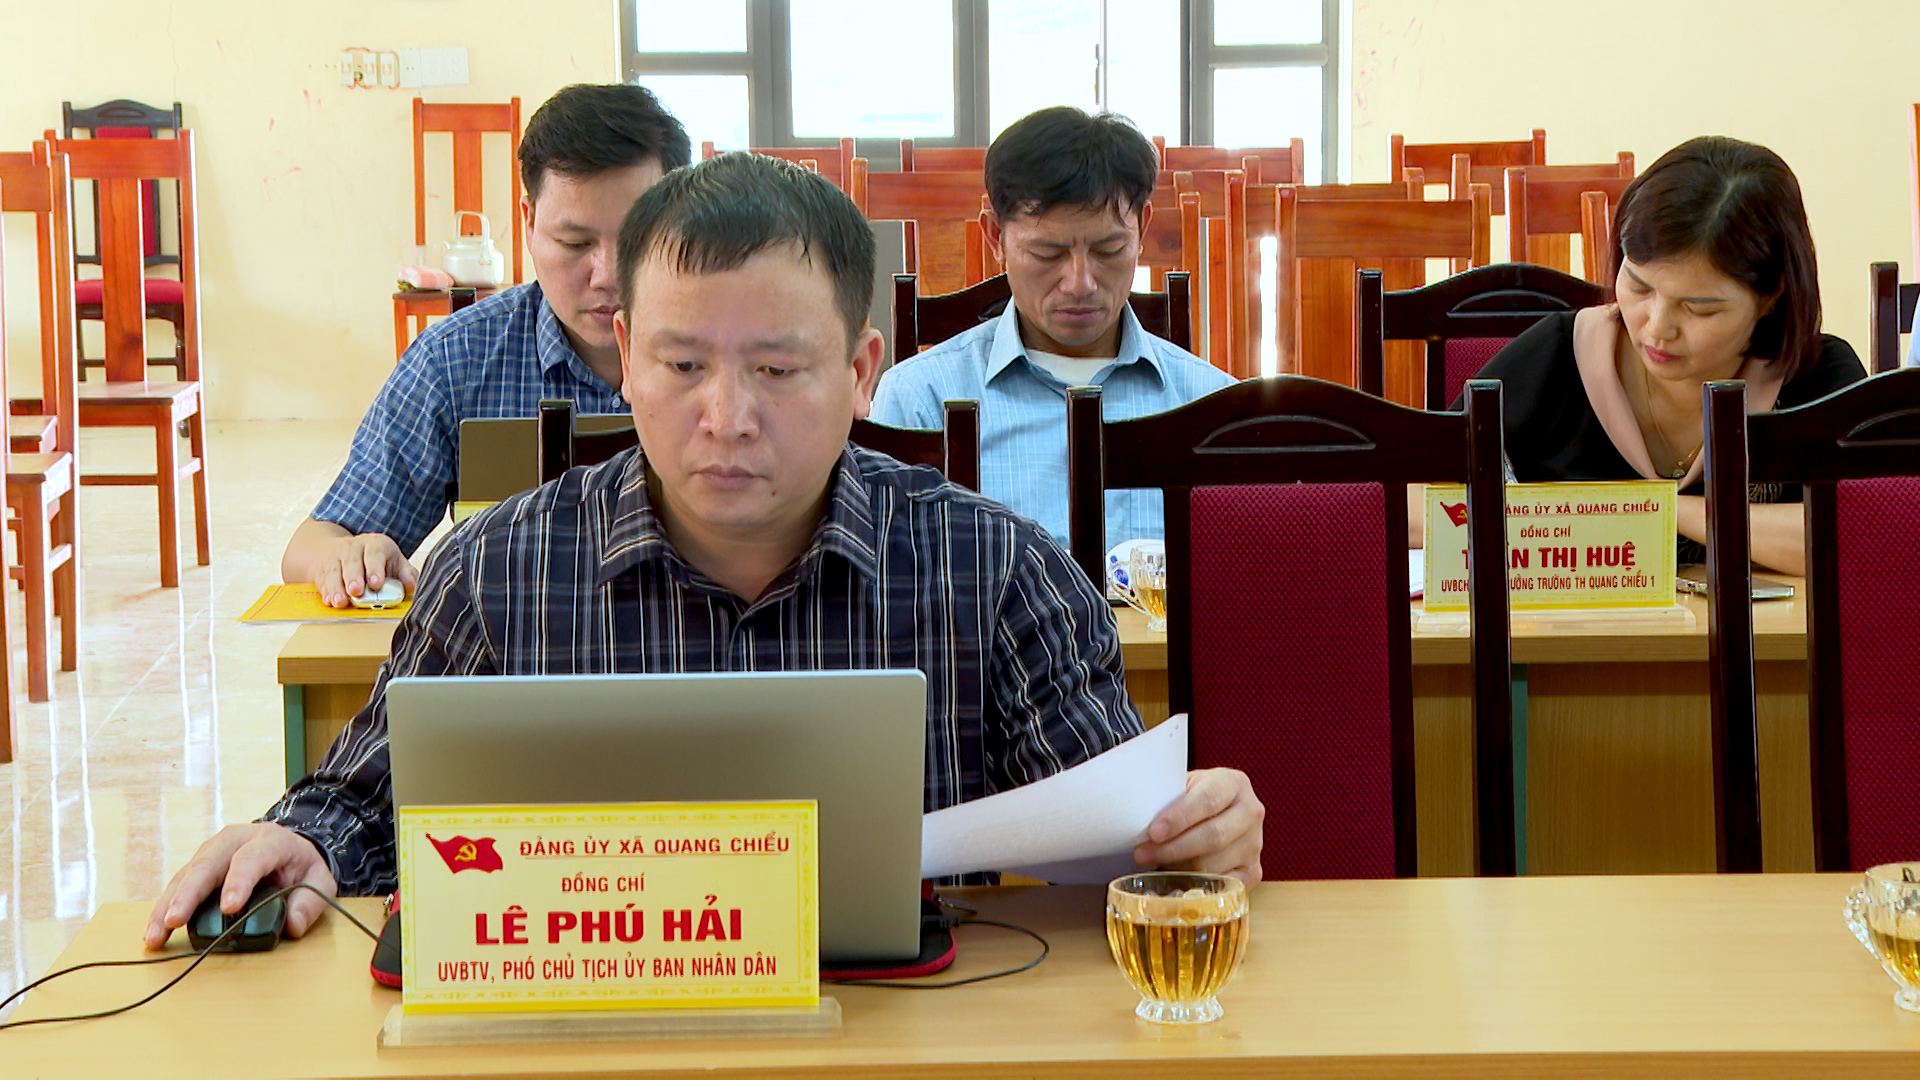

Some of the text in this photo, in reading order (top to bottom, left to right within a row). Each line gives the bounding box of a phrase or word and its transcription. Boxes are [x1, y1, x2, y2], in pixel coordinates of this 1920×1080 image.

[1577, 502, 1617, 515] QUANG
[1553, 524, 1571, 538] CHÍ
[1538, 547, 1577, 572] THỊ
[1586, 541, 1636, 571] HUỆ
[1575, 577, 1586, 590] TH
[1588, 575, 1618, 588] QUANG
[1650, 575, 1655, 588] 1
[519, 831, 790, 856] ĐẢNG ỦY XÃ QUANG CHIỂU
[617, 871, 645, 892] CHÍ
[475, 893, 742, 946] LÊ PHÚ HẢI
[438, 951, 777, 983] UVBTV, PHÓ CHỦ TỊCH ỦY BAN NHÂN DÂN
